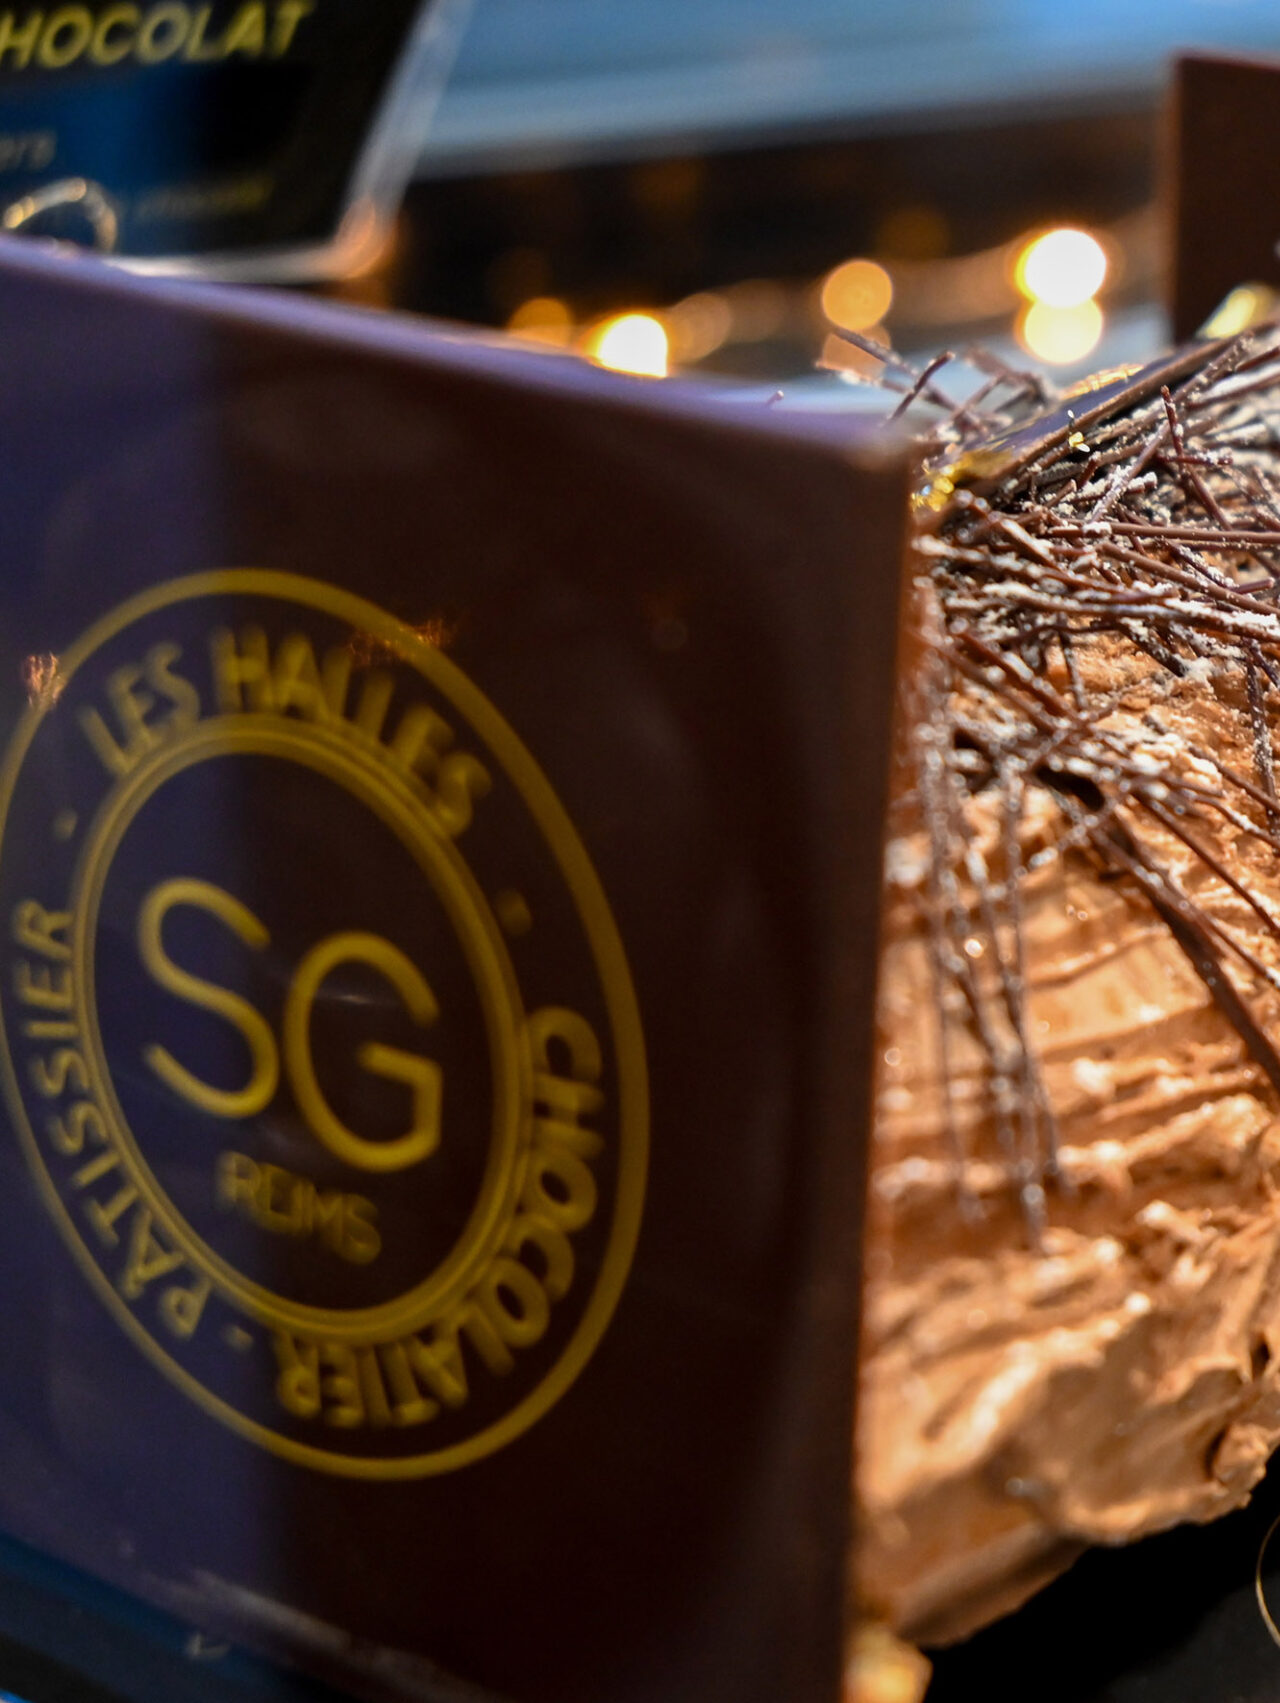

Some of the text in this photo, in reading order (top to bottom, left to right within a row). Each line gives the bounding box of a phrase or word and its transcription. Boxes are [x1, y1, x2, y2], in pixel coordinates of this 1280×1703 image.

[77, 622, 493, 840] LES HALLES
[13, 899, 212, 1340] PÂTISSIER
[138, 877, 442, 1174] SG
[276, 1005, 605, 1429] CHOCOLATIER
